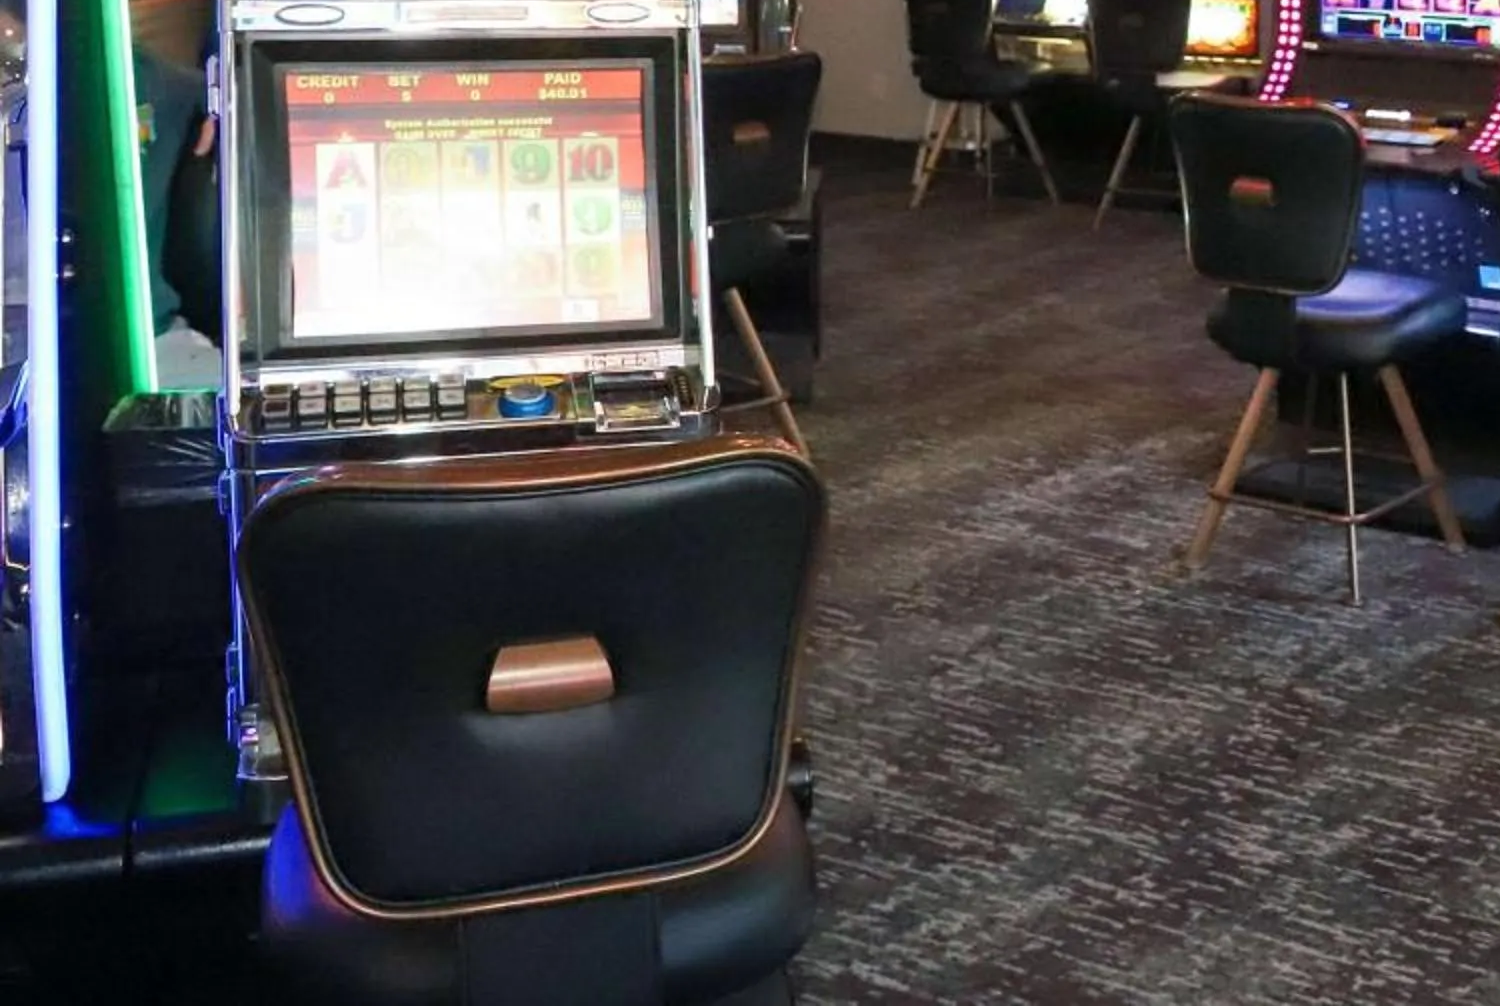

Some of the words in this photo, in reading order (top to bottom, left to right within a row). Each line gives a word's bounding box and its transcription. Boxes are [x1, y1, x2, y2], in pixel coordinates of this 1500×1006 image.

[296, 75, 360, 89] CREDIT
[388, 74, 421, 88] BET
[456, 72, 490, 86] WIN
[543, 71, 582, 85] PAID
